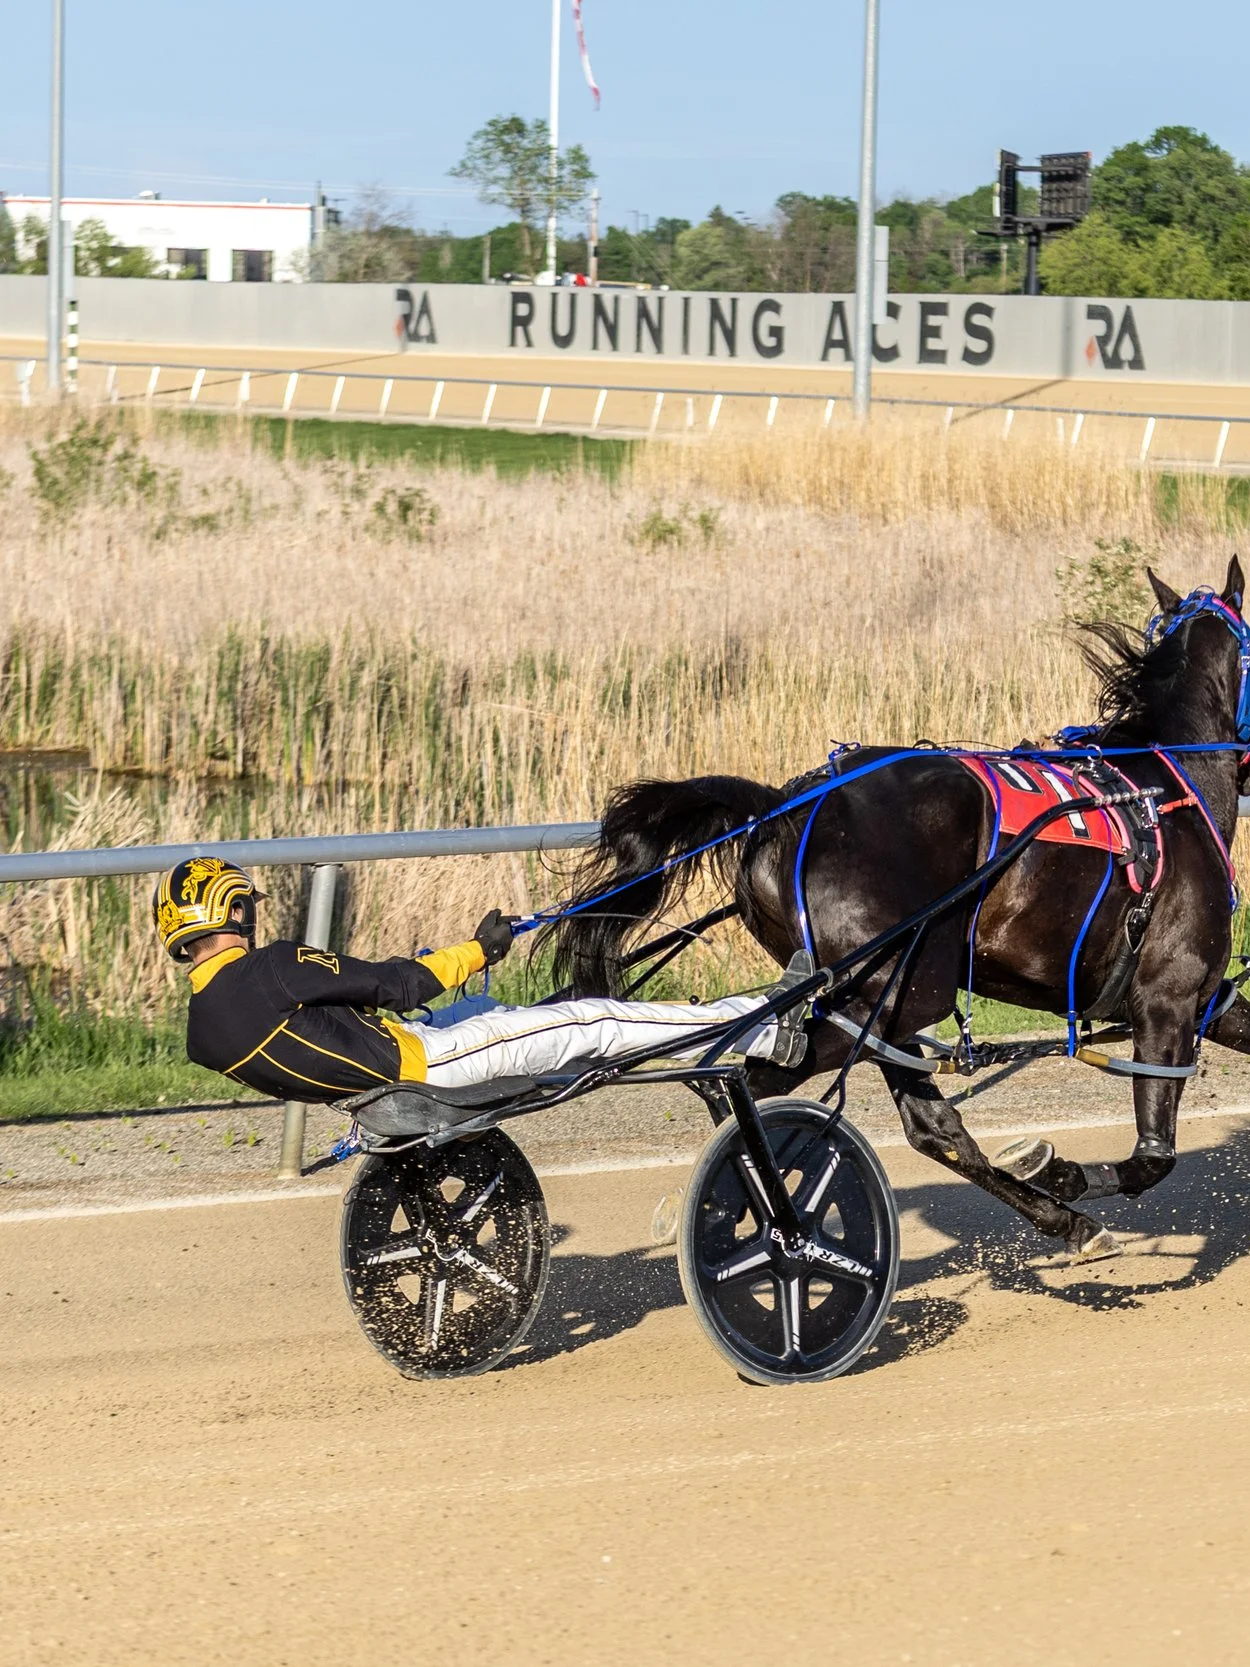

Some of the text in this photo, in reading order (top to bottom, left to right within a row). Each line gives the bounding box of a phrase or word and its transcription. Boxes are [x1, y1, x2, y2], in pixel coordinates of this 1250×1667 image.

[396, 288, 438, 344] RA
[509, 291, 996, 366] RUNNING ACES
[1086, 304, 1146, 370] RA
